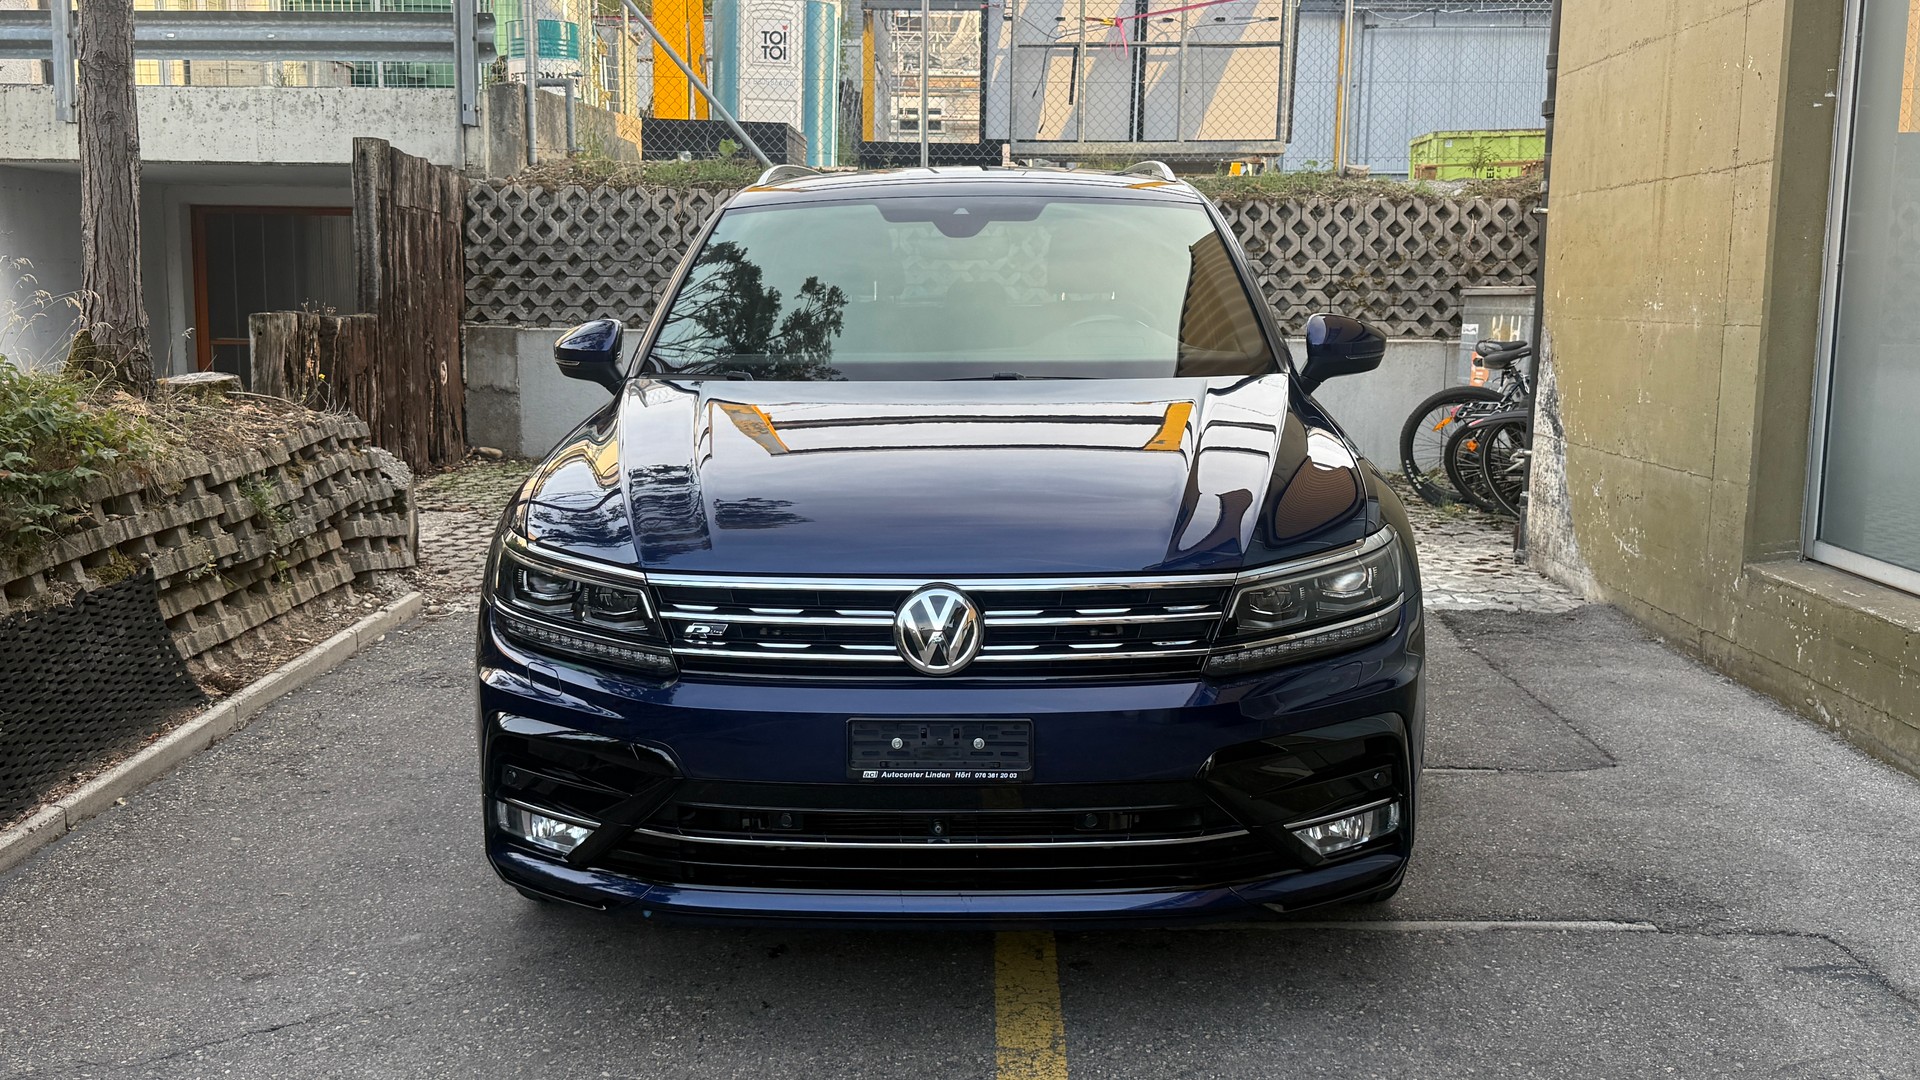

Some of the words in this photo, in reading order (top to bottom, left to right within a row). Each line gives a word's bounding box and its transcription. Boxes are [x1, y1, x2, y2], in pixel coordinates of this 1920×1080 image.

[761, 30, 786, 45] TOI
[761, 45, 786, 60] TOI
[955, 771, 972, 779] Höri
